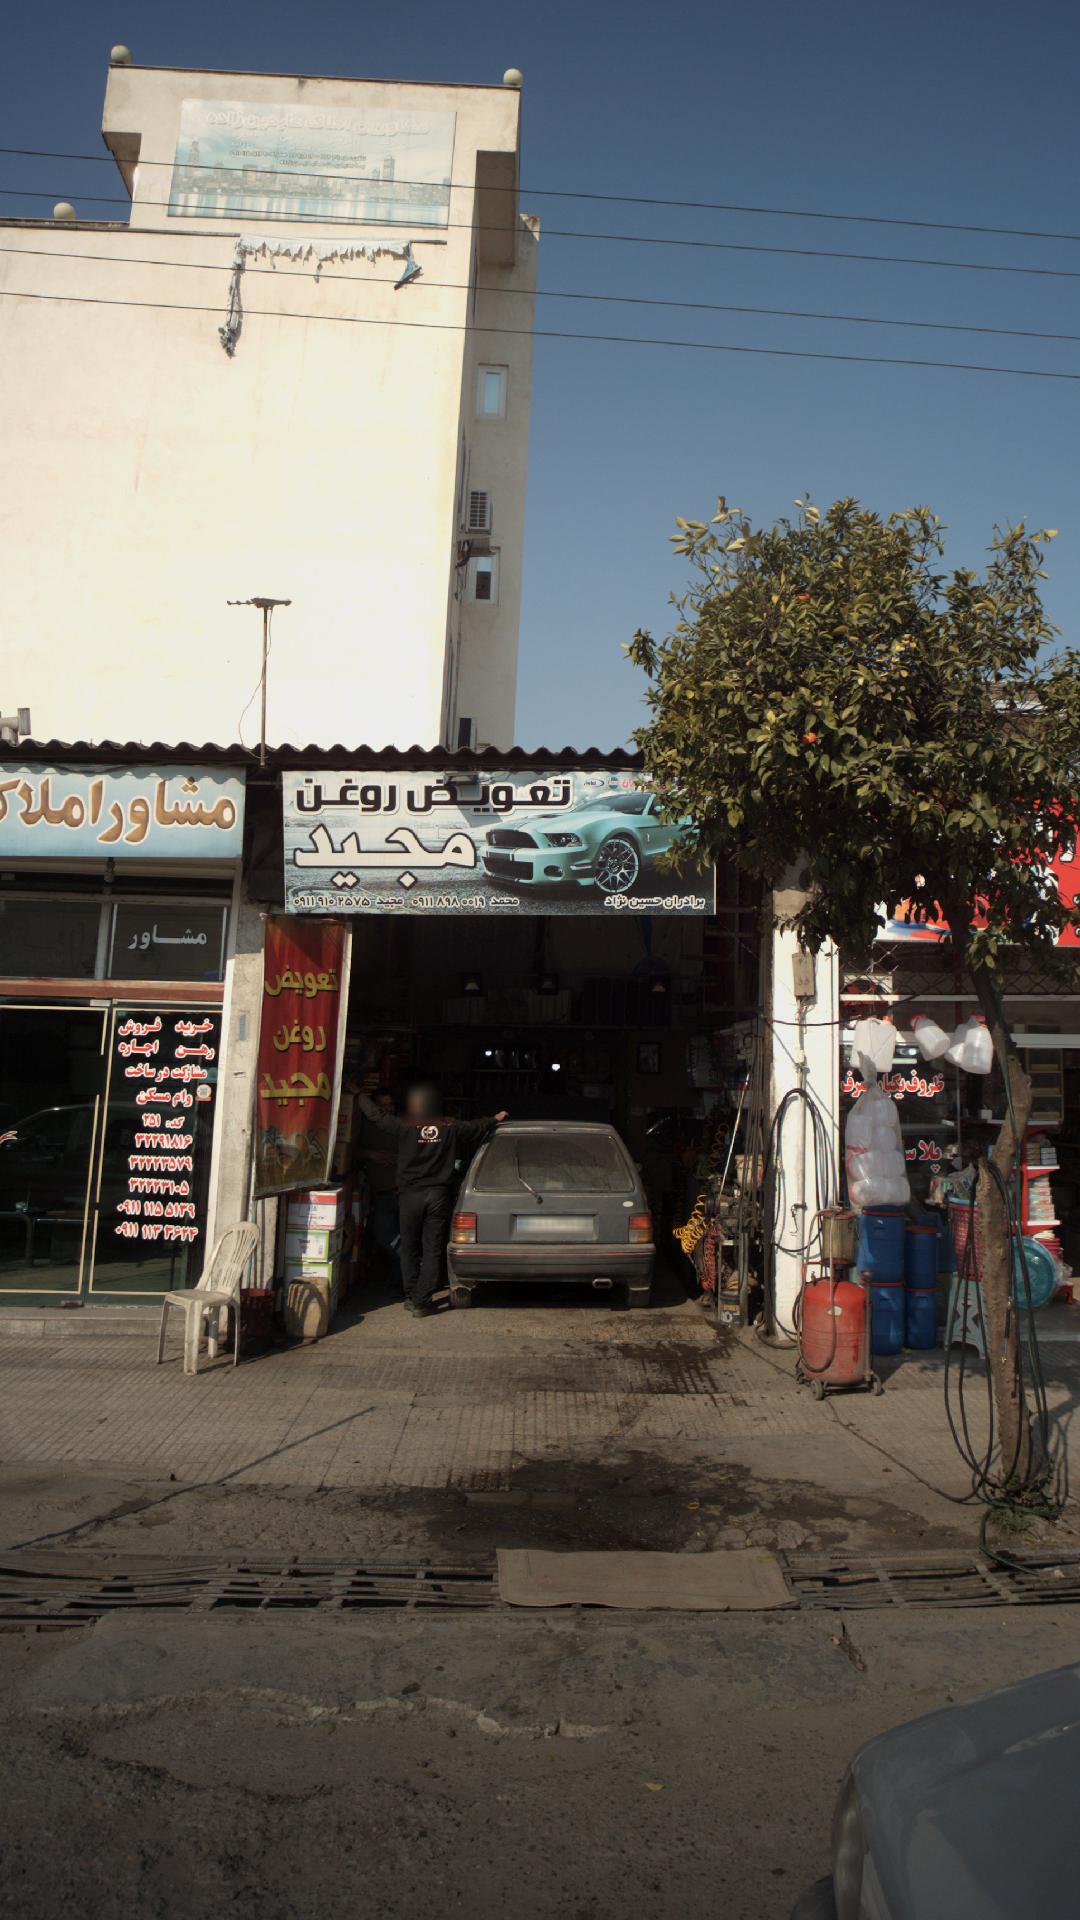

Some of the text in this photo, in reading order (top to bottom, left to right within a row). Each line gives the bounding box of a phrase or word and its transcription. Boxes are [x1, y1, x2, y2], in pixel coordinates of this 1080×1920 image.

[296, 777, 574, 815] تعویض روغن
[97, 776, 237, 843] مشاور
[293, 823, 477, 889] مجید
[294, 896, 519, 909] محمد ۰۹۱۱ ۸۹۸ ۰۰۱۹ مجید ۰۹۱۱ ۹۱۰ ۲۵۷۵
[604, 894, 706, 910] برادران حسین نژاد
[128, 924, 207, 950] مشاور
[265, 965, 338, 997] تعویض
[118, 1016, 213, 1036] خرید فروش
[273, 1019, 326, 1051] روغن
[118, 1038, 215, 1059] رهن اجاره
[125, 1062, 208, 1083] مشارکت در ساخت
[905, 1069, 945, 1097] ظروف
[136, 1087, 193, 1107] وام مسکن
[260, 1072, 331, 1106] مجید
[904, 1139, 942, 1173] پلاس
[116, 1199, 141, 1215] ۰۹۱۱
[144, 1201, 164, 1216] ۱۱۵
[114, 1221, 139, 1238] ۰۹۱۱
